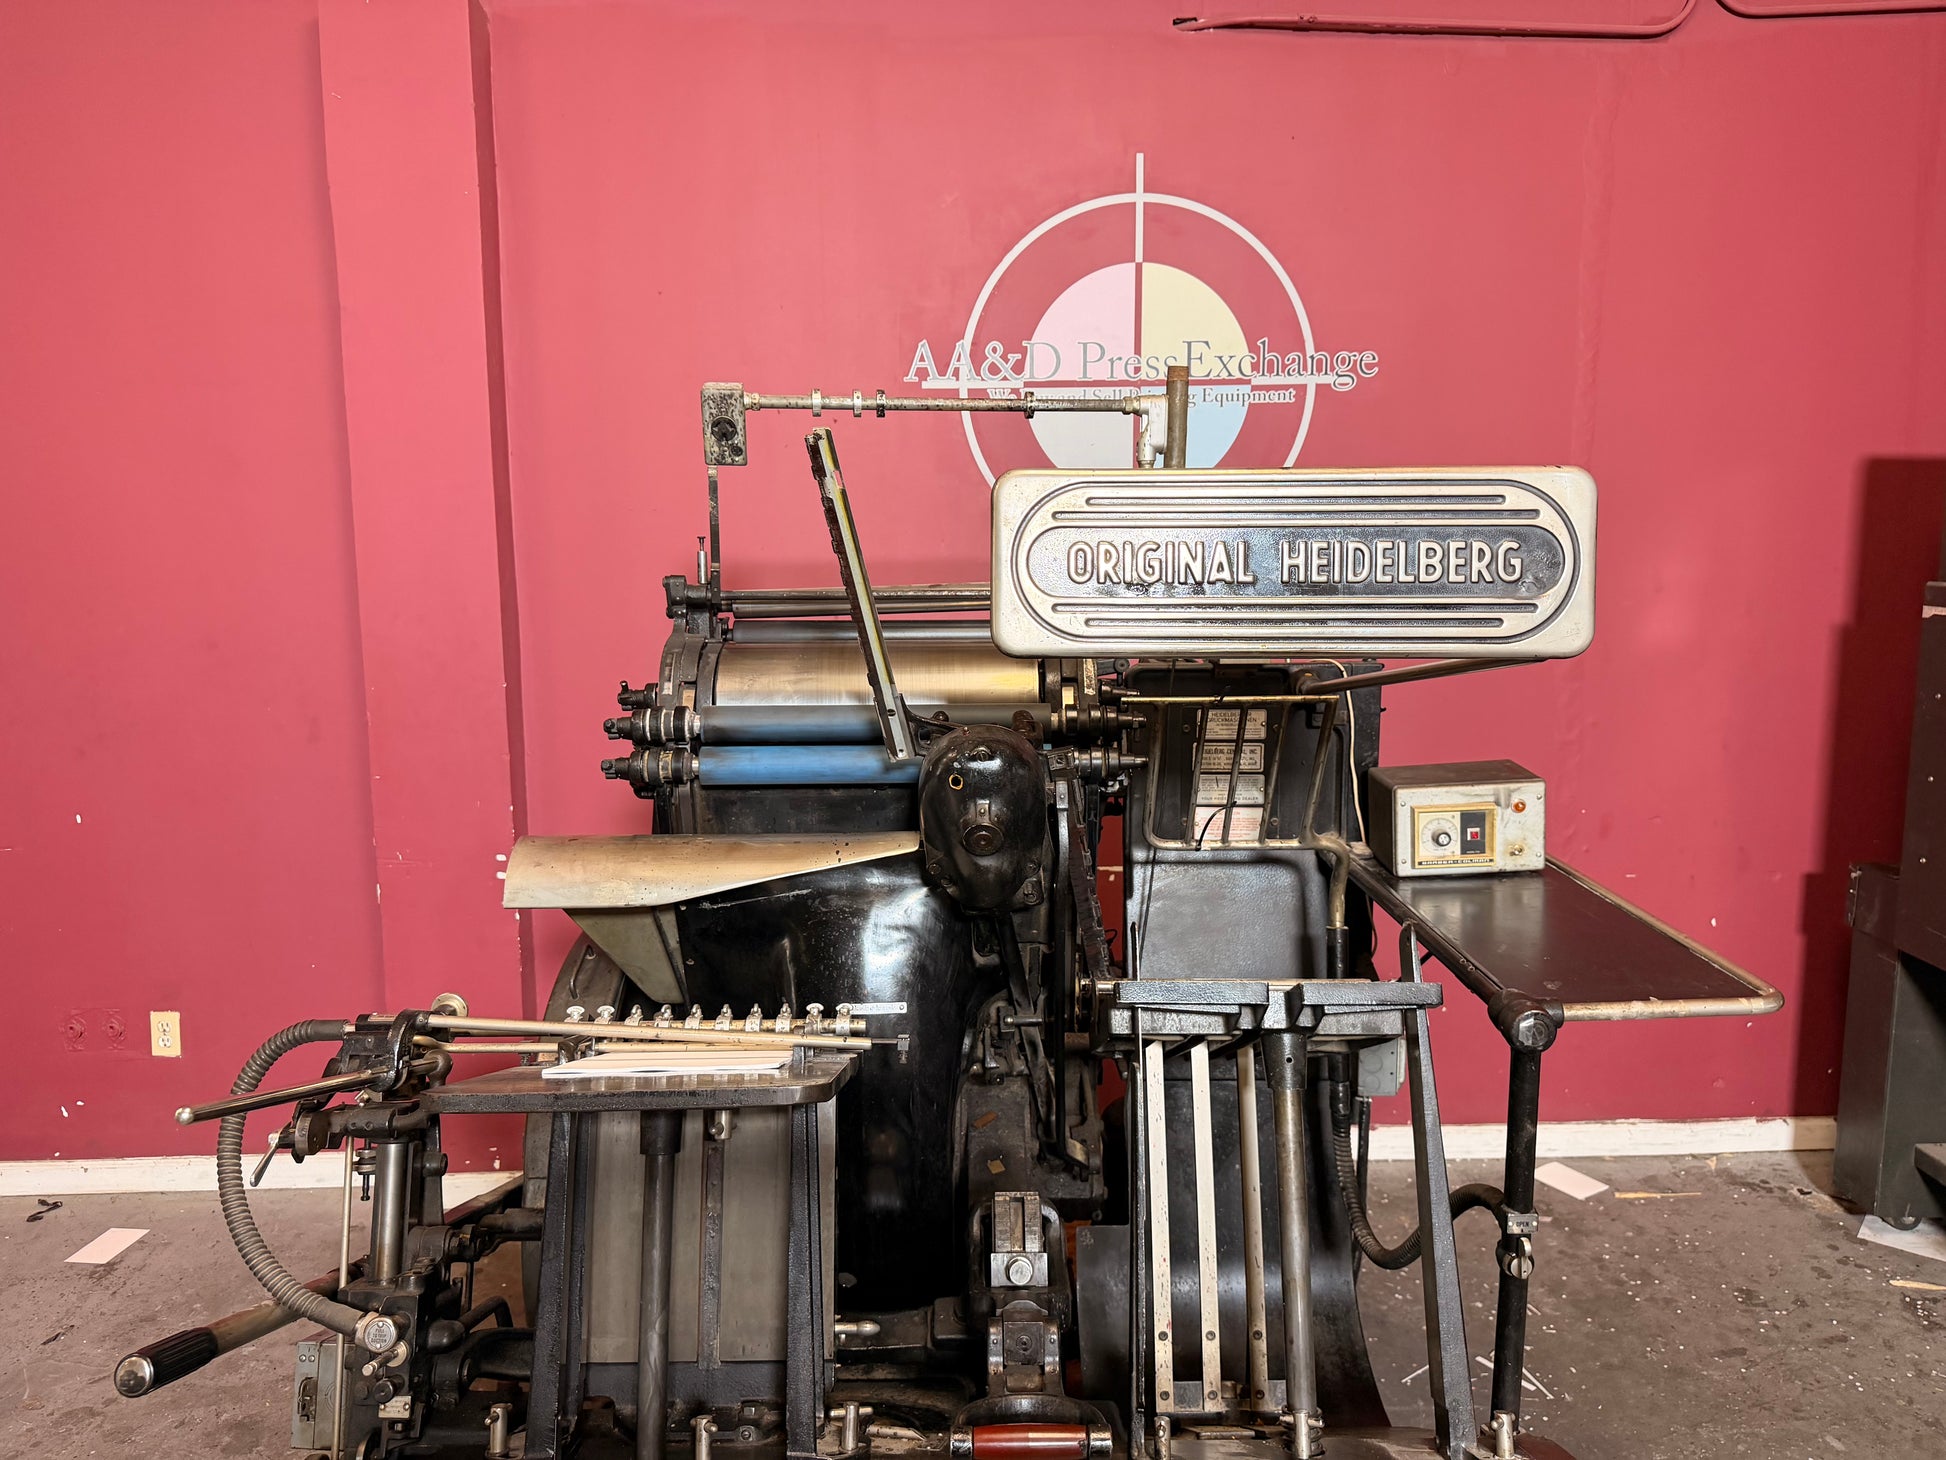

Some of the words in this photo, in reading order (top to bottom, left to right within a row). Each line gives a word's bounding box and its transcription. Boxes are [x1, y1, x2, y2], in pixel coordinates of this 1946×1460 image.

[904, 339, 1061, 382] AA&D
[1077, 341, 1177, 380] Press
[1182, 337, 1378, 390] Exchange
[1202, 387, 1296, 408] Equipment
[1067, 540, 1256, 585] ORIGINAL
[1280, 540, 1524, 584] HEIDELBERG
